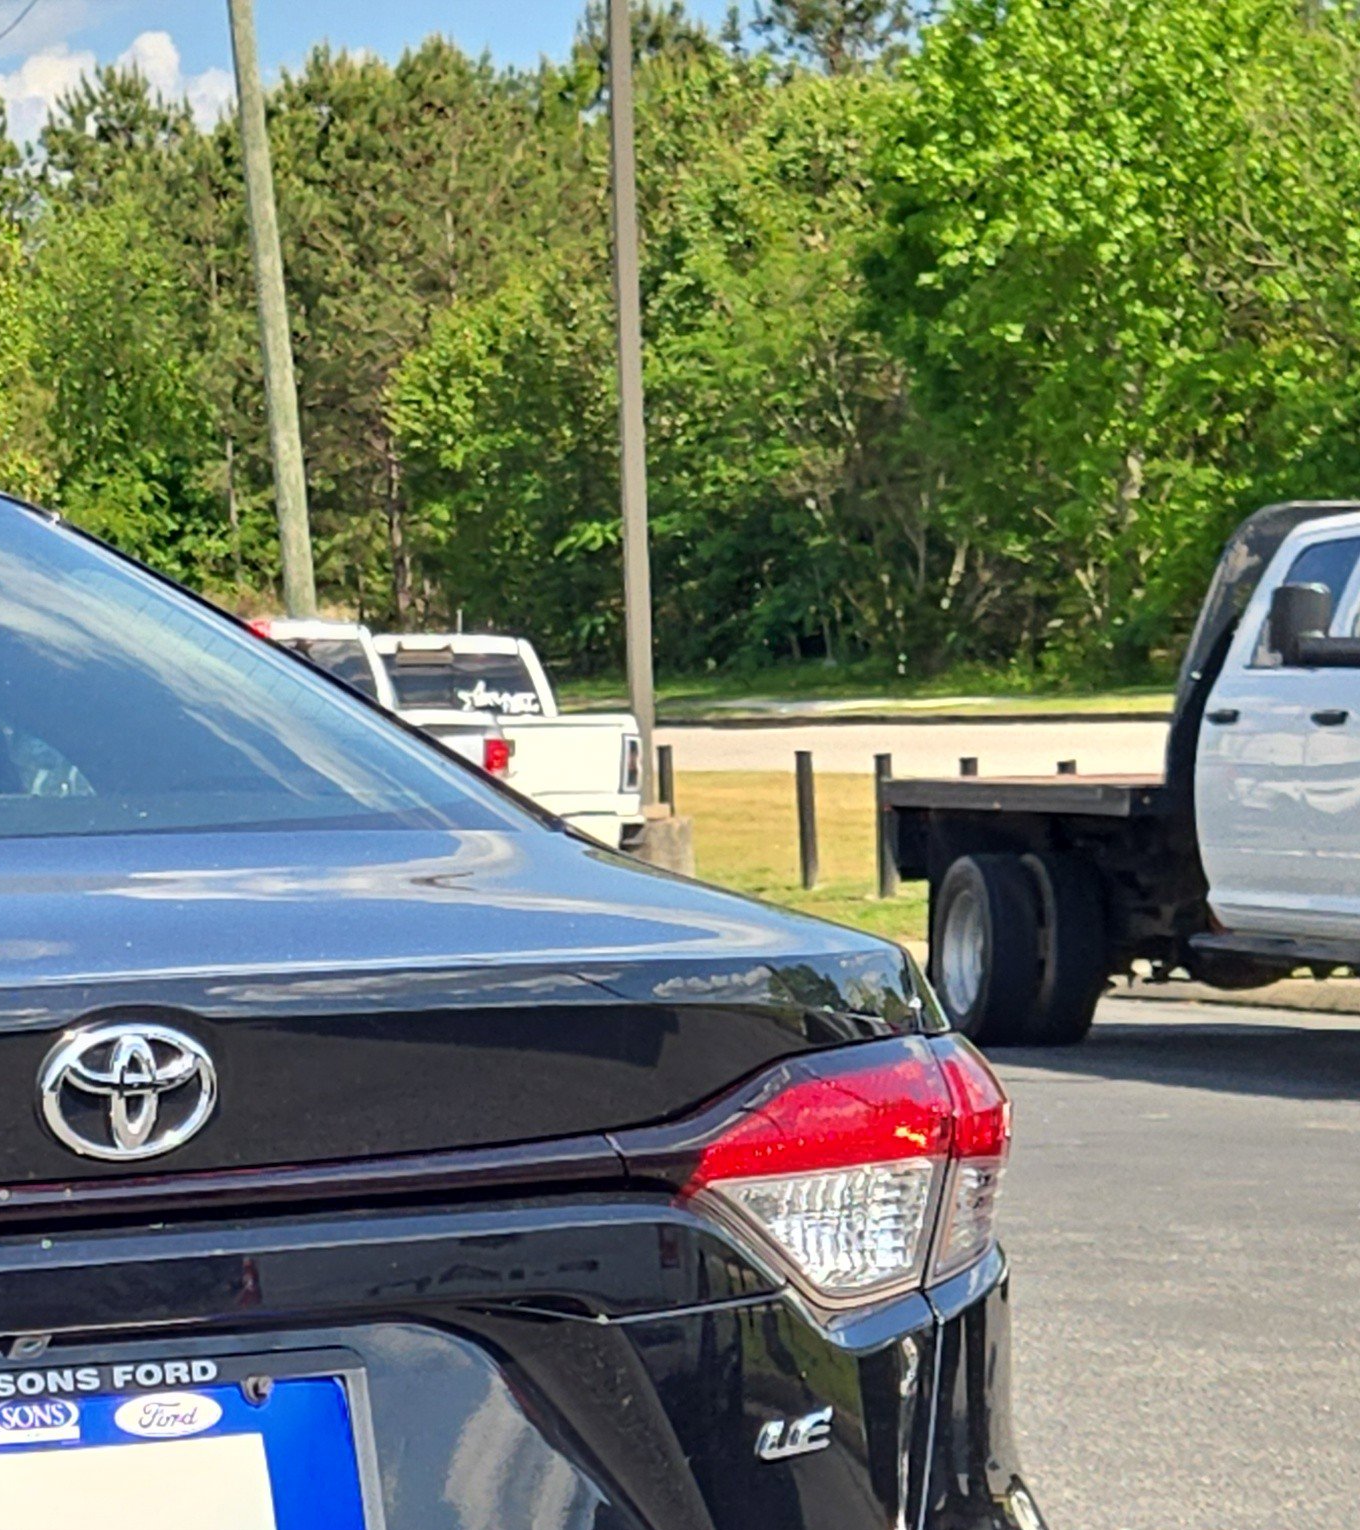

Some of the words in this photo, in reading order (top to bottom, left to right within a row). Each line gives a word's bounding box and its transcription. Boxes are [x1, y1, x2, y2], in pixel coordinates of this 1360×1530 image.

[112, 1360, 218, 1389] FORD
[0, 1403, 66, 1429] SONS
[138, 1401, 199, 1429] Ford
[754, 1405, 833, 1460] LE
